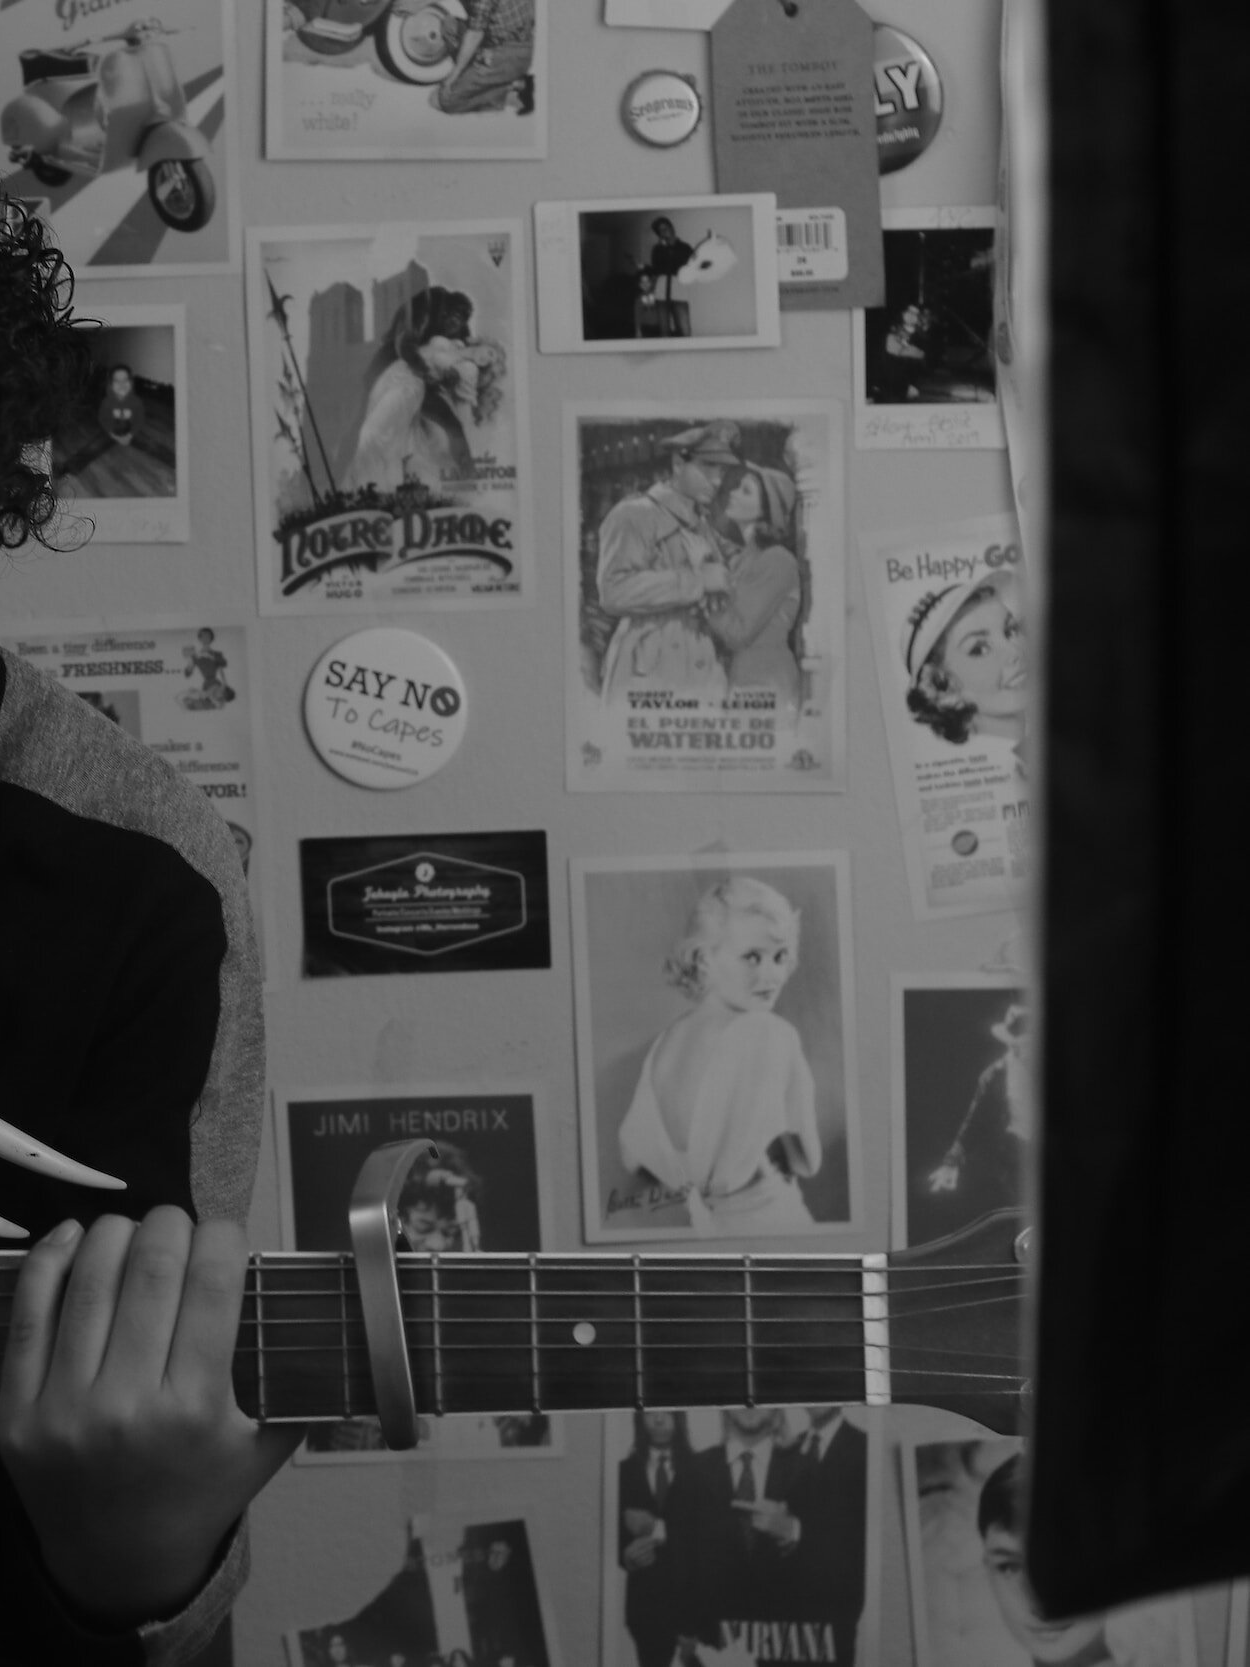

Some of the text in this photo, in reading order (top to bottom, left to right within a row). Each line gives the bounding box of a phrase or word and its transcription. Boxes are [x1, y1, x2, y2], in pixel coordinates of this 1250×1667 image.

[301, 111, 359, 132] white!
[273, 508, 513, 582] NOTRE DAME
[886, 557, 915, 583] Be
[16, 642, 48, 657] Even
[51, 646, 60, 655] a
[91, 638, 156, 653] difference
[324, 660, 462, 718] SAY NO
[627, 699, 777, 710] TAYLOR LEIGH
[326, 695, 445, 748] To Capes
[627, 717, 776, 730] EL PUENTE DE
[626, 731, 776, 750] WATERLOO
[197, 784, 247, 799] VOR!
[312, 1108, 513, 1138] JIMI HENDRIX
[717, 1619, 837, 1663] NIRVANA
